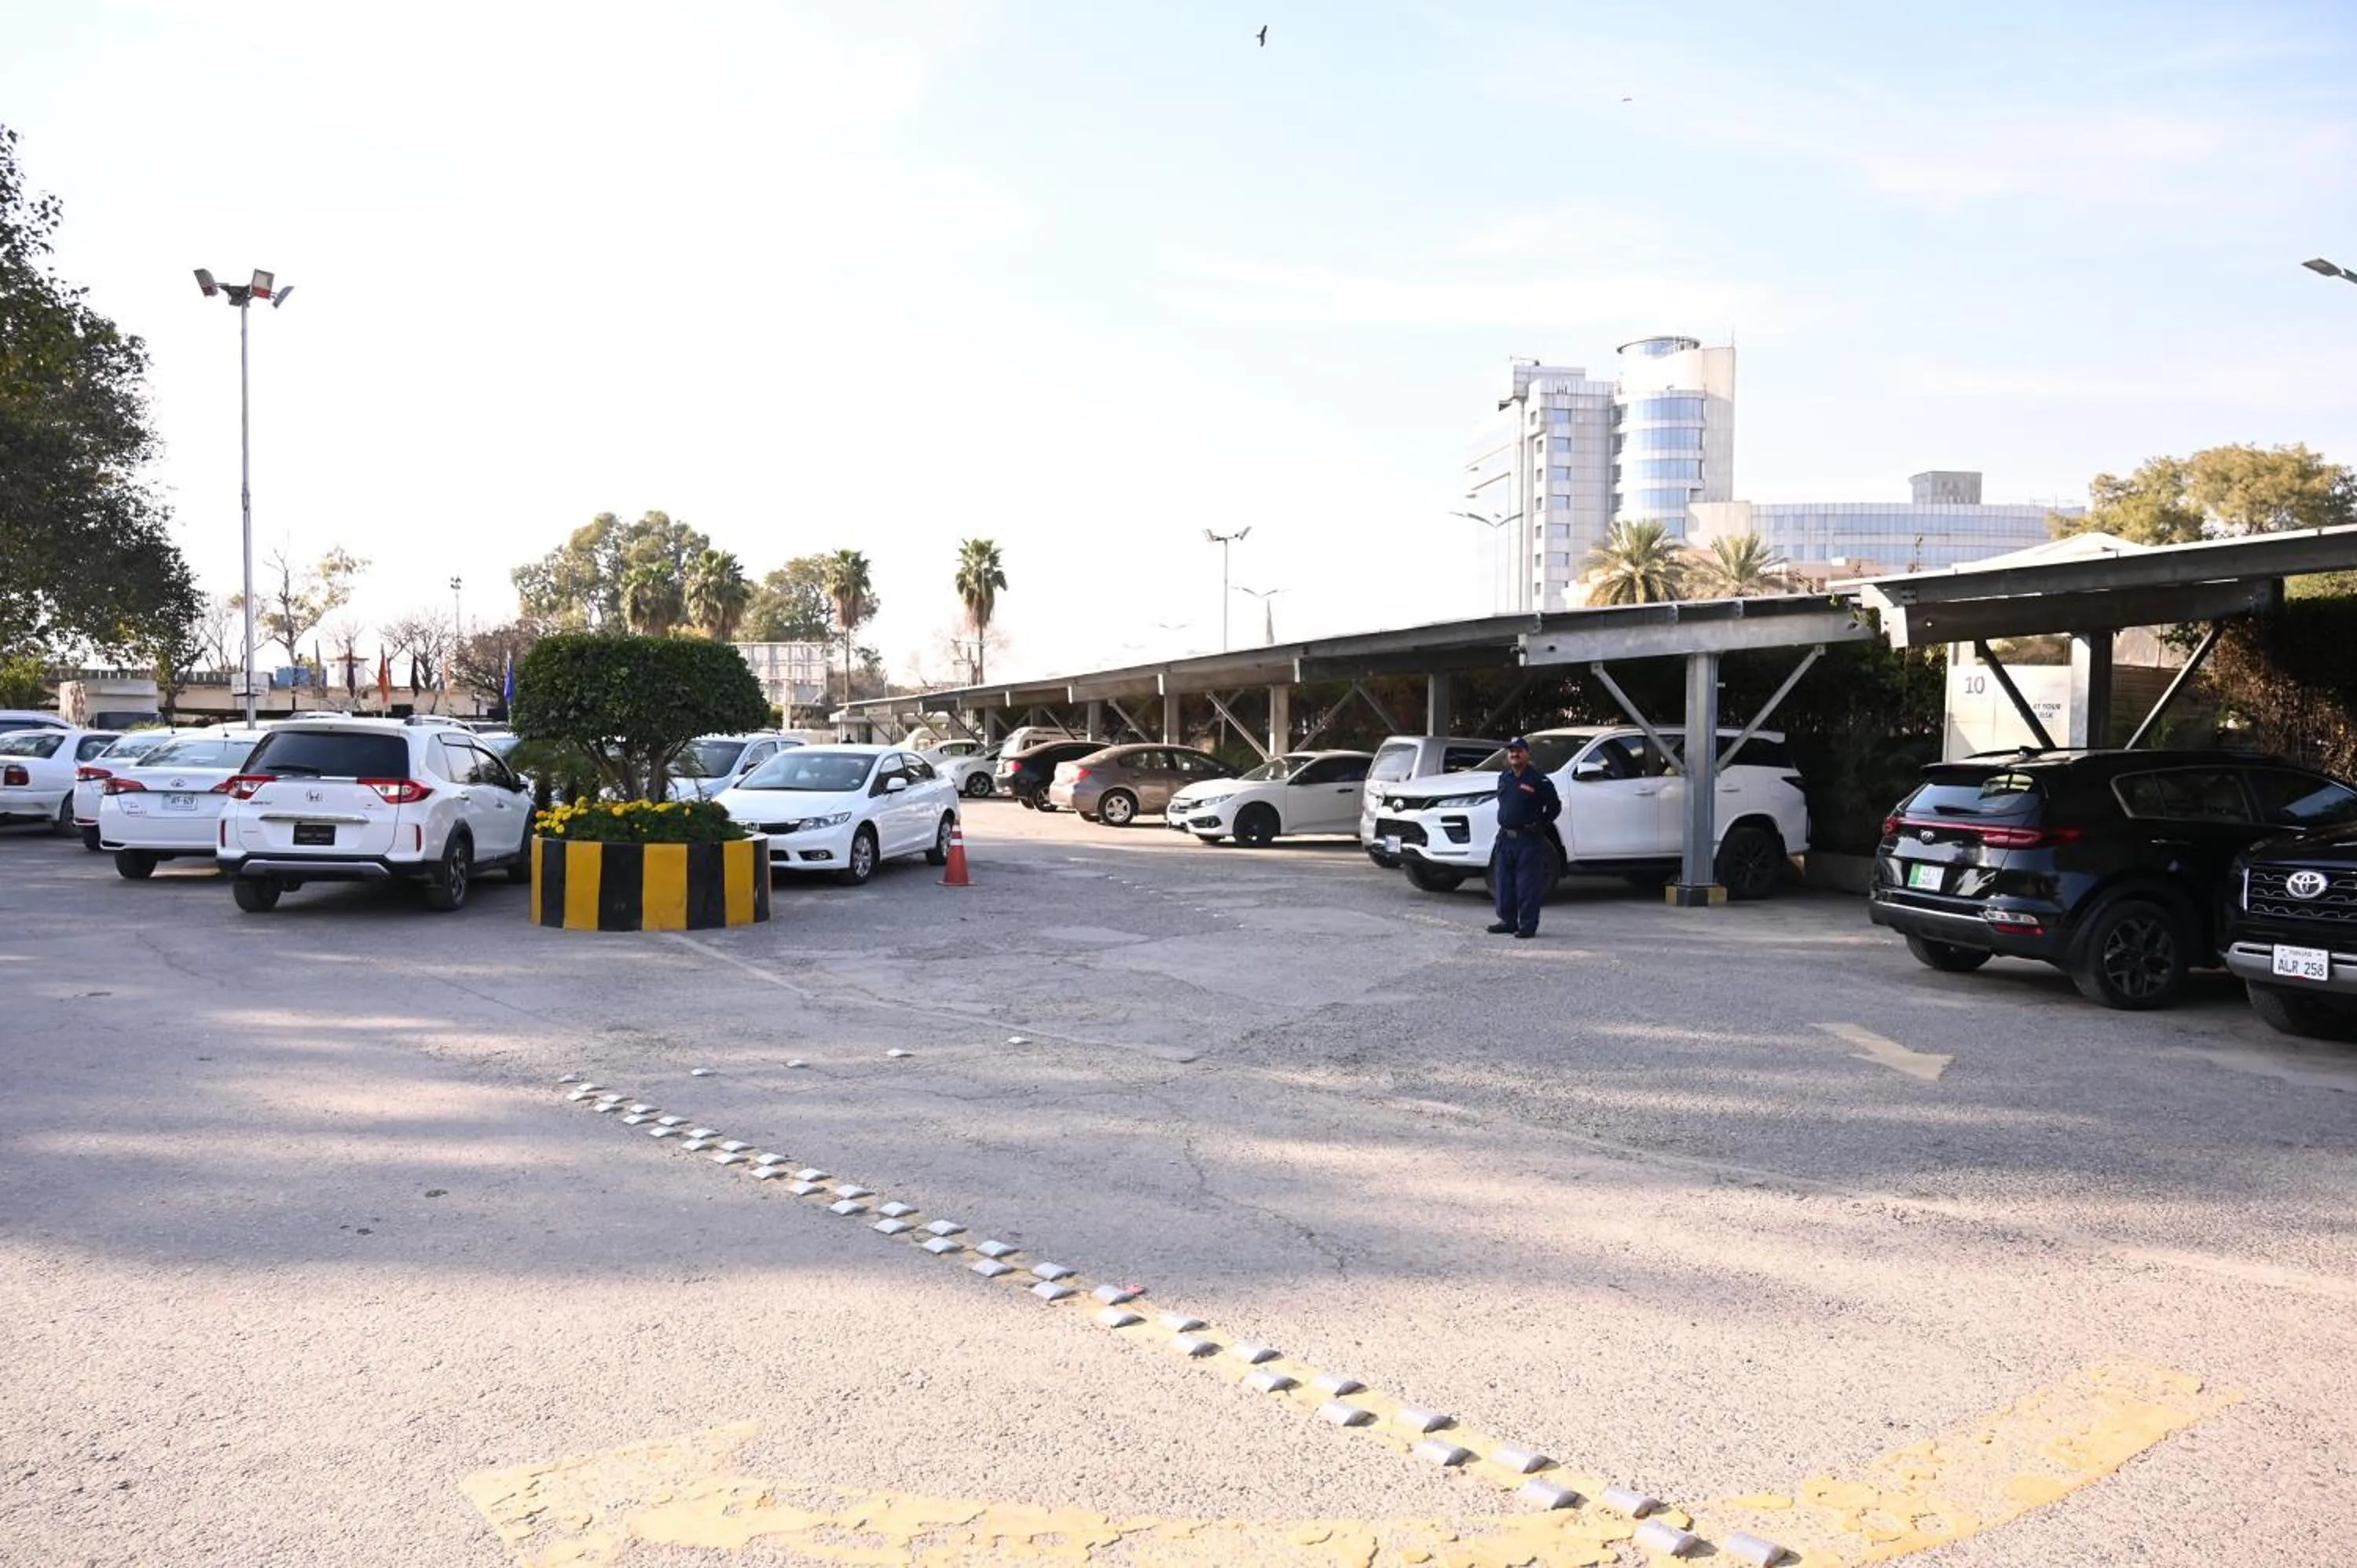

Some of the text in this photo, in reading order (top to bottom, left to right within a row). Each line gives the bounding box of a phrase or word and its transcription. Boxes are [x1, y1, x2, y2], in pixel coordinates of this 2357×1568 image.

[1965, 676, 1985, 694] 10
[2278, 958, 2325, 976] ALR 258
